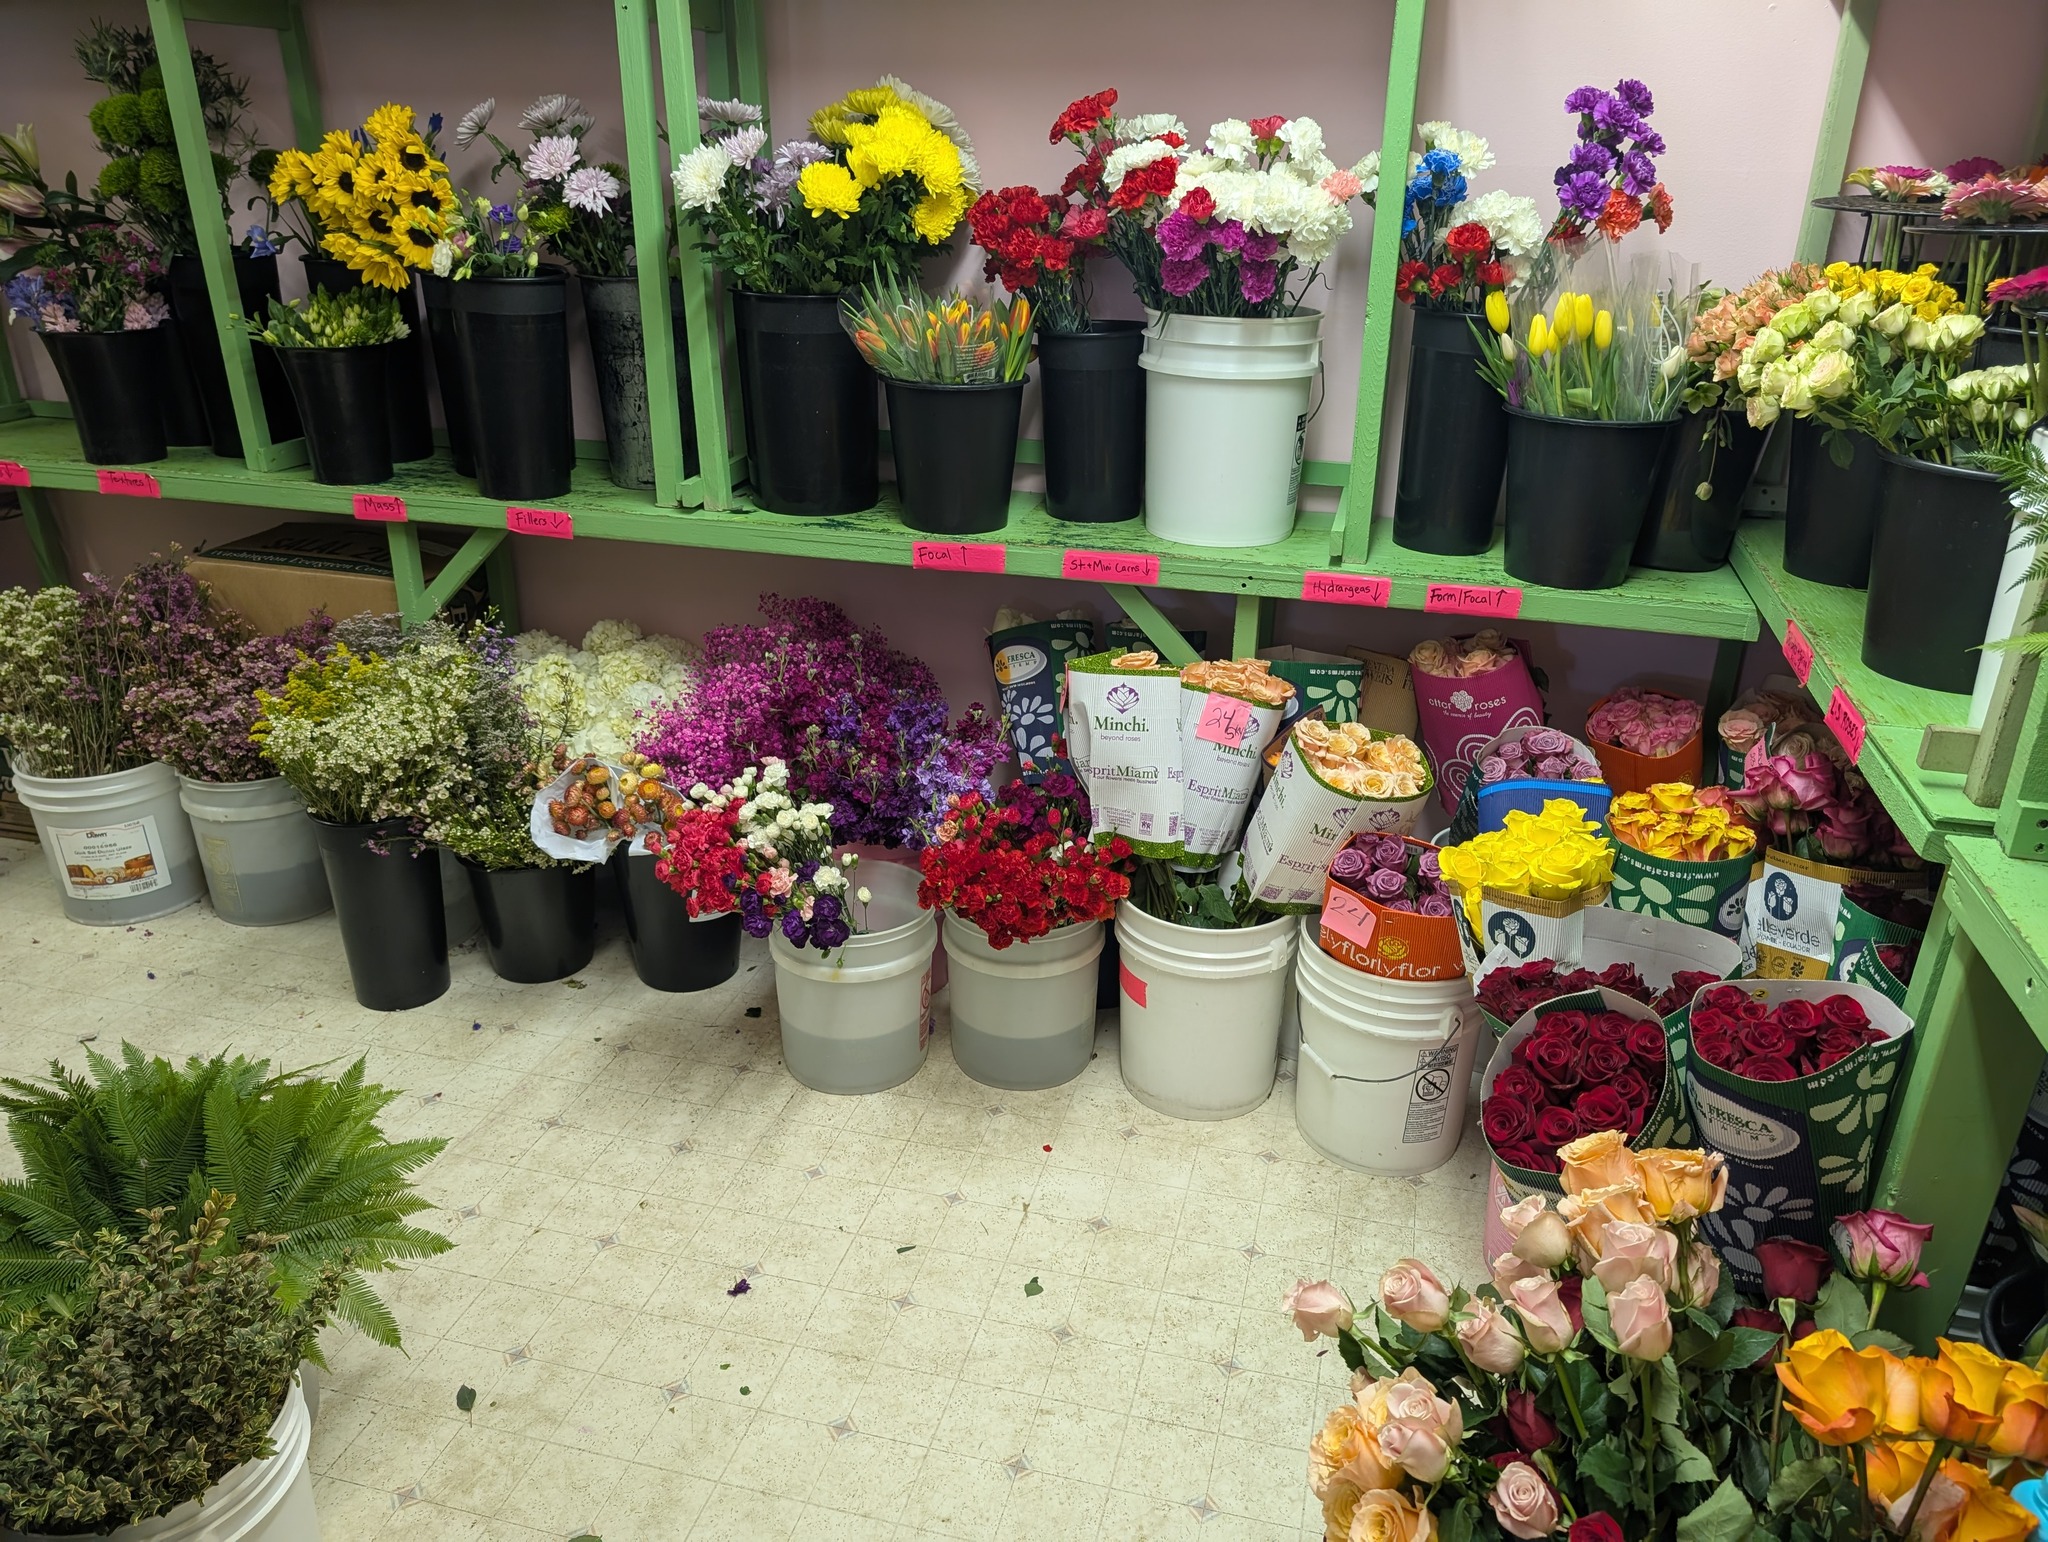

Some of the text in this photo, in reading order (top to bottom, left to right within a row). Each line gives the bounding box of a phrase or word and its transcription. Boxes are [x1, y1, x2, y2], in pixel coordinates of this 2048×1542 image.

[107, 470, 144, 487] Textures
[363, 496, 395, 513] Mass
[515, 512, 547, 527] Fillers
[210, 549, 287, 563] Washington
[289, 556, 352, 570] Evergreen
[917, 546, 952, 564] Focal
[1312, 579, 1372, 599] Hydrangeas
[1006, 651, 1036, 663] FRESCA
[1474, 696, 1507, 711] roses
[1094, 715, 1149, 733] Minchi.
[1205, 707, 1237, 734] 24
[1101, 733, 1124, 742] beyond
[1329, 896, 1371, 927] 24
[1782, 940, 1811, 953] ECUADOR
[1707, 1102, 1773, 1134] FRESCA
